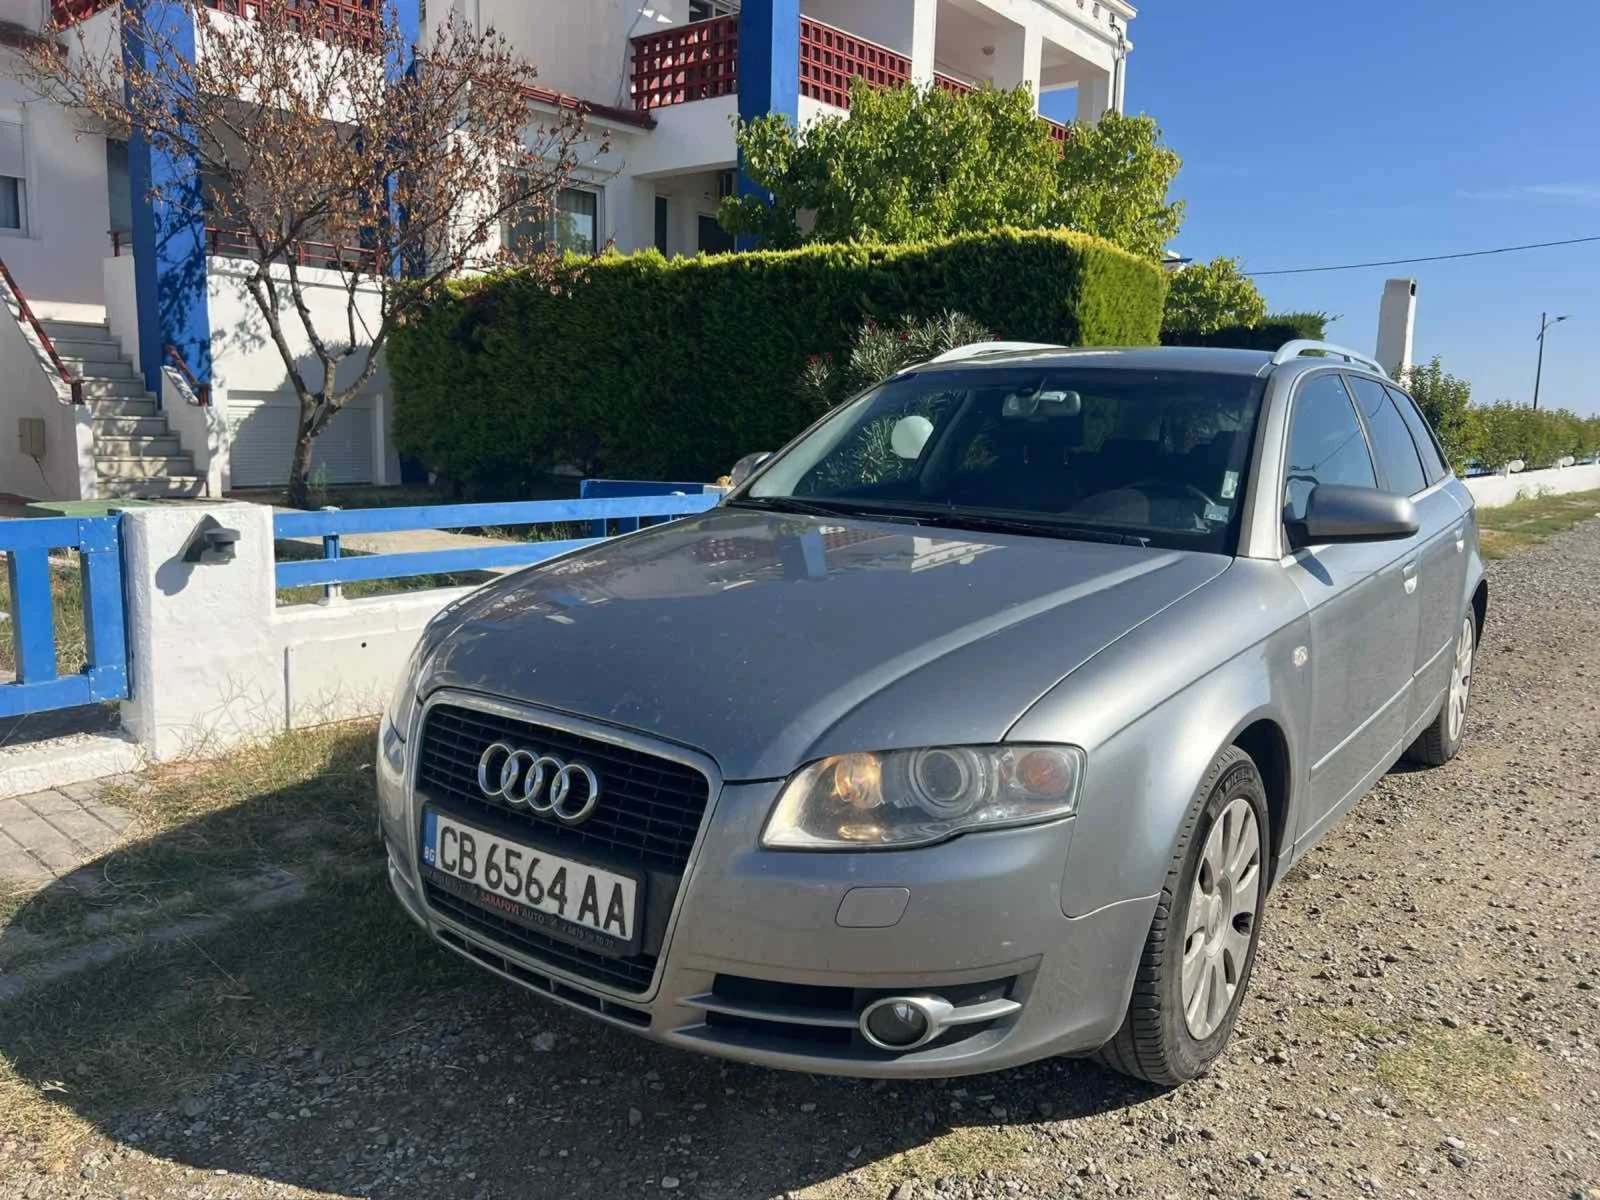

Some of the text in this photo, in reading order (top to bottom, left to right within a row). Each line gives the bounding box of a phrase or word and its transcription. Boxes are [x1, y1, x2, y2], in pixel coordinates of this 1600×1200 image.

[424, 846, 435, 862] BG
[440, 826, 476, 880] CB
[484, 843, 568, 915] 6564
[578, 874, 626, 937] AA
